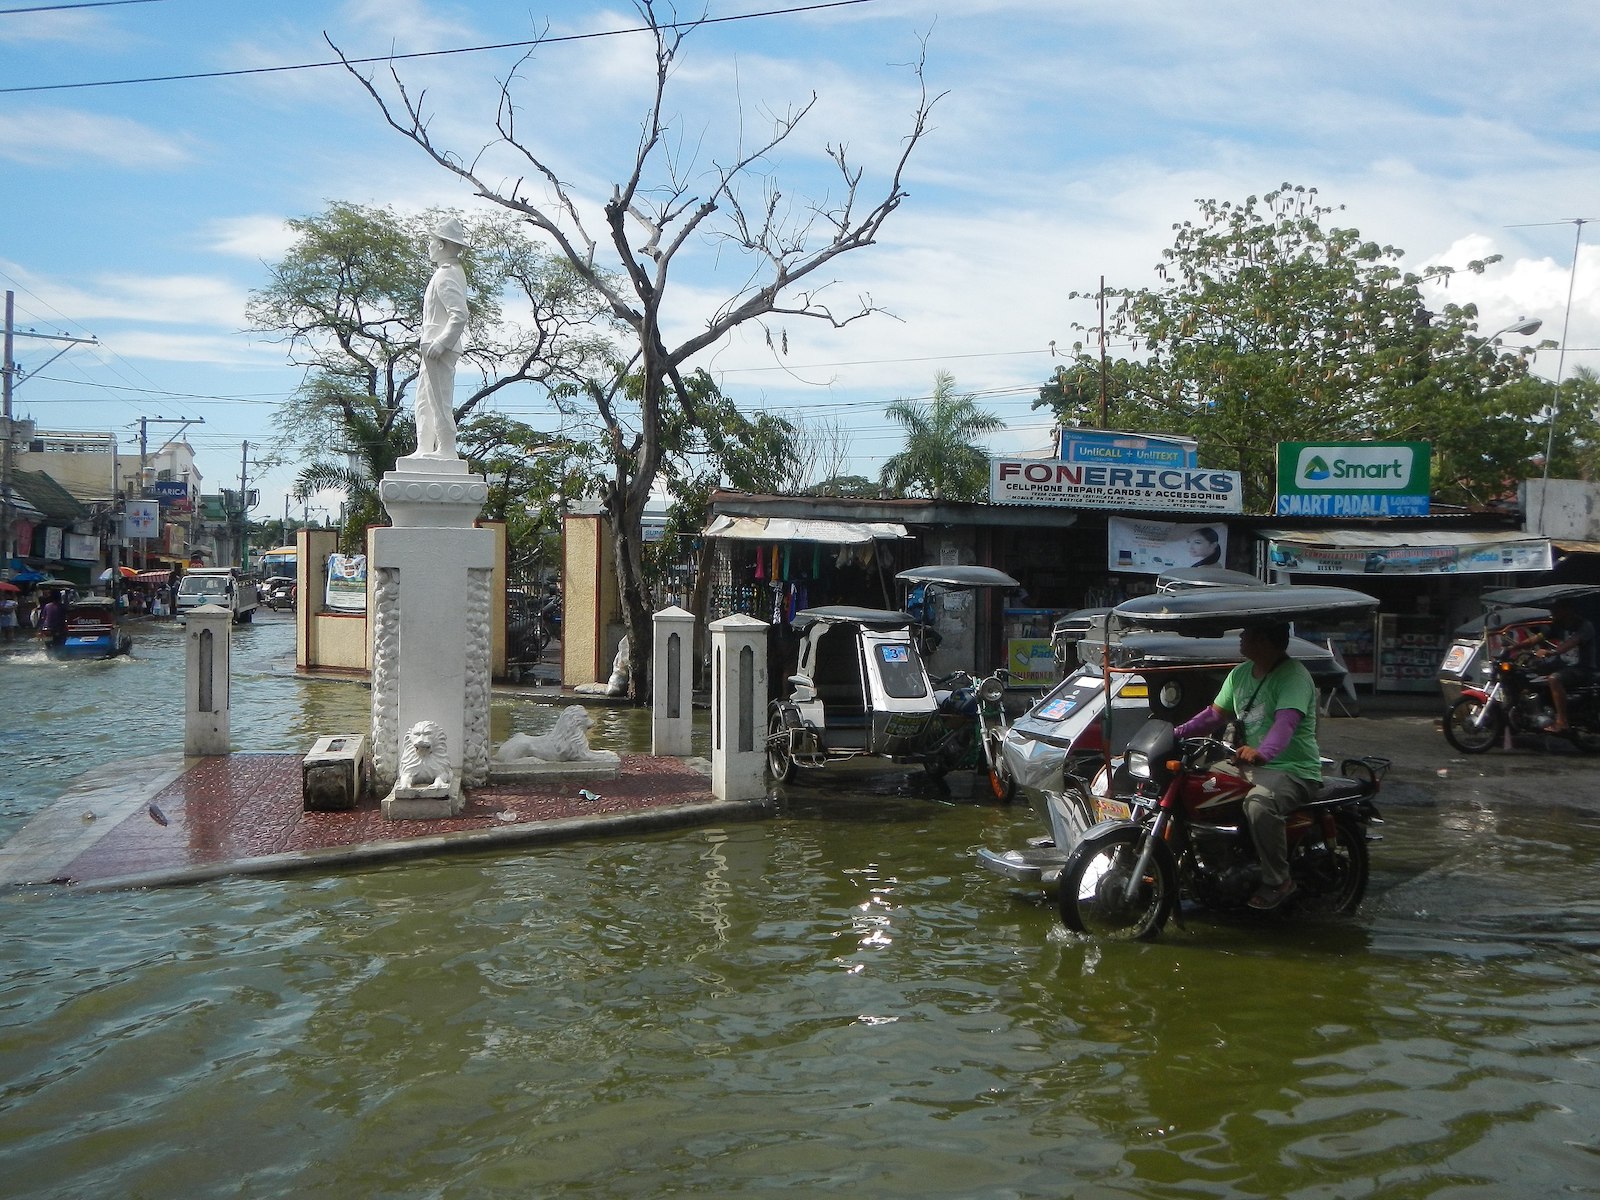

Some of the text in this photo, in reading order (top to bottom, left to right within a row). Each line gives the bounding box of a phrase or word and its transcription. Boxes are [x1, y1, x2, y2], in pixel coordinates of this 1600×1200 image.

[1080, 447, 1122, 458] UnliCALL
[1137, 451, 1179, 461] UnliTEXT
[1333, 459, 1402, 478] Smart
[1006, 483, 1063, 493] CELLPHONE
[1107, 488, 1141, 497] CARDS
[1155, 490, 1228, 501] ACCESSORIES
[1279, 494, 1389, 515] SMART PADALA
[889, 648, 899, 659] 3
